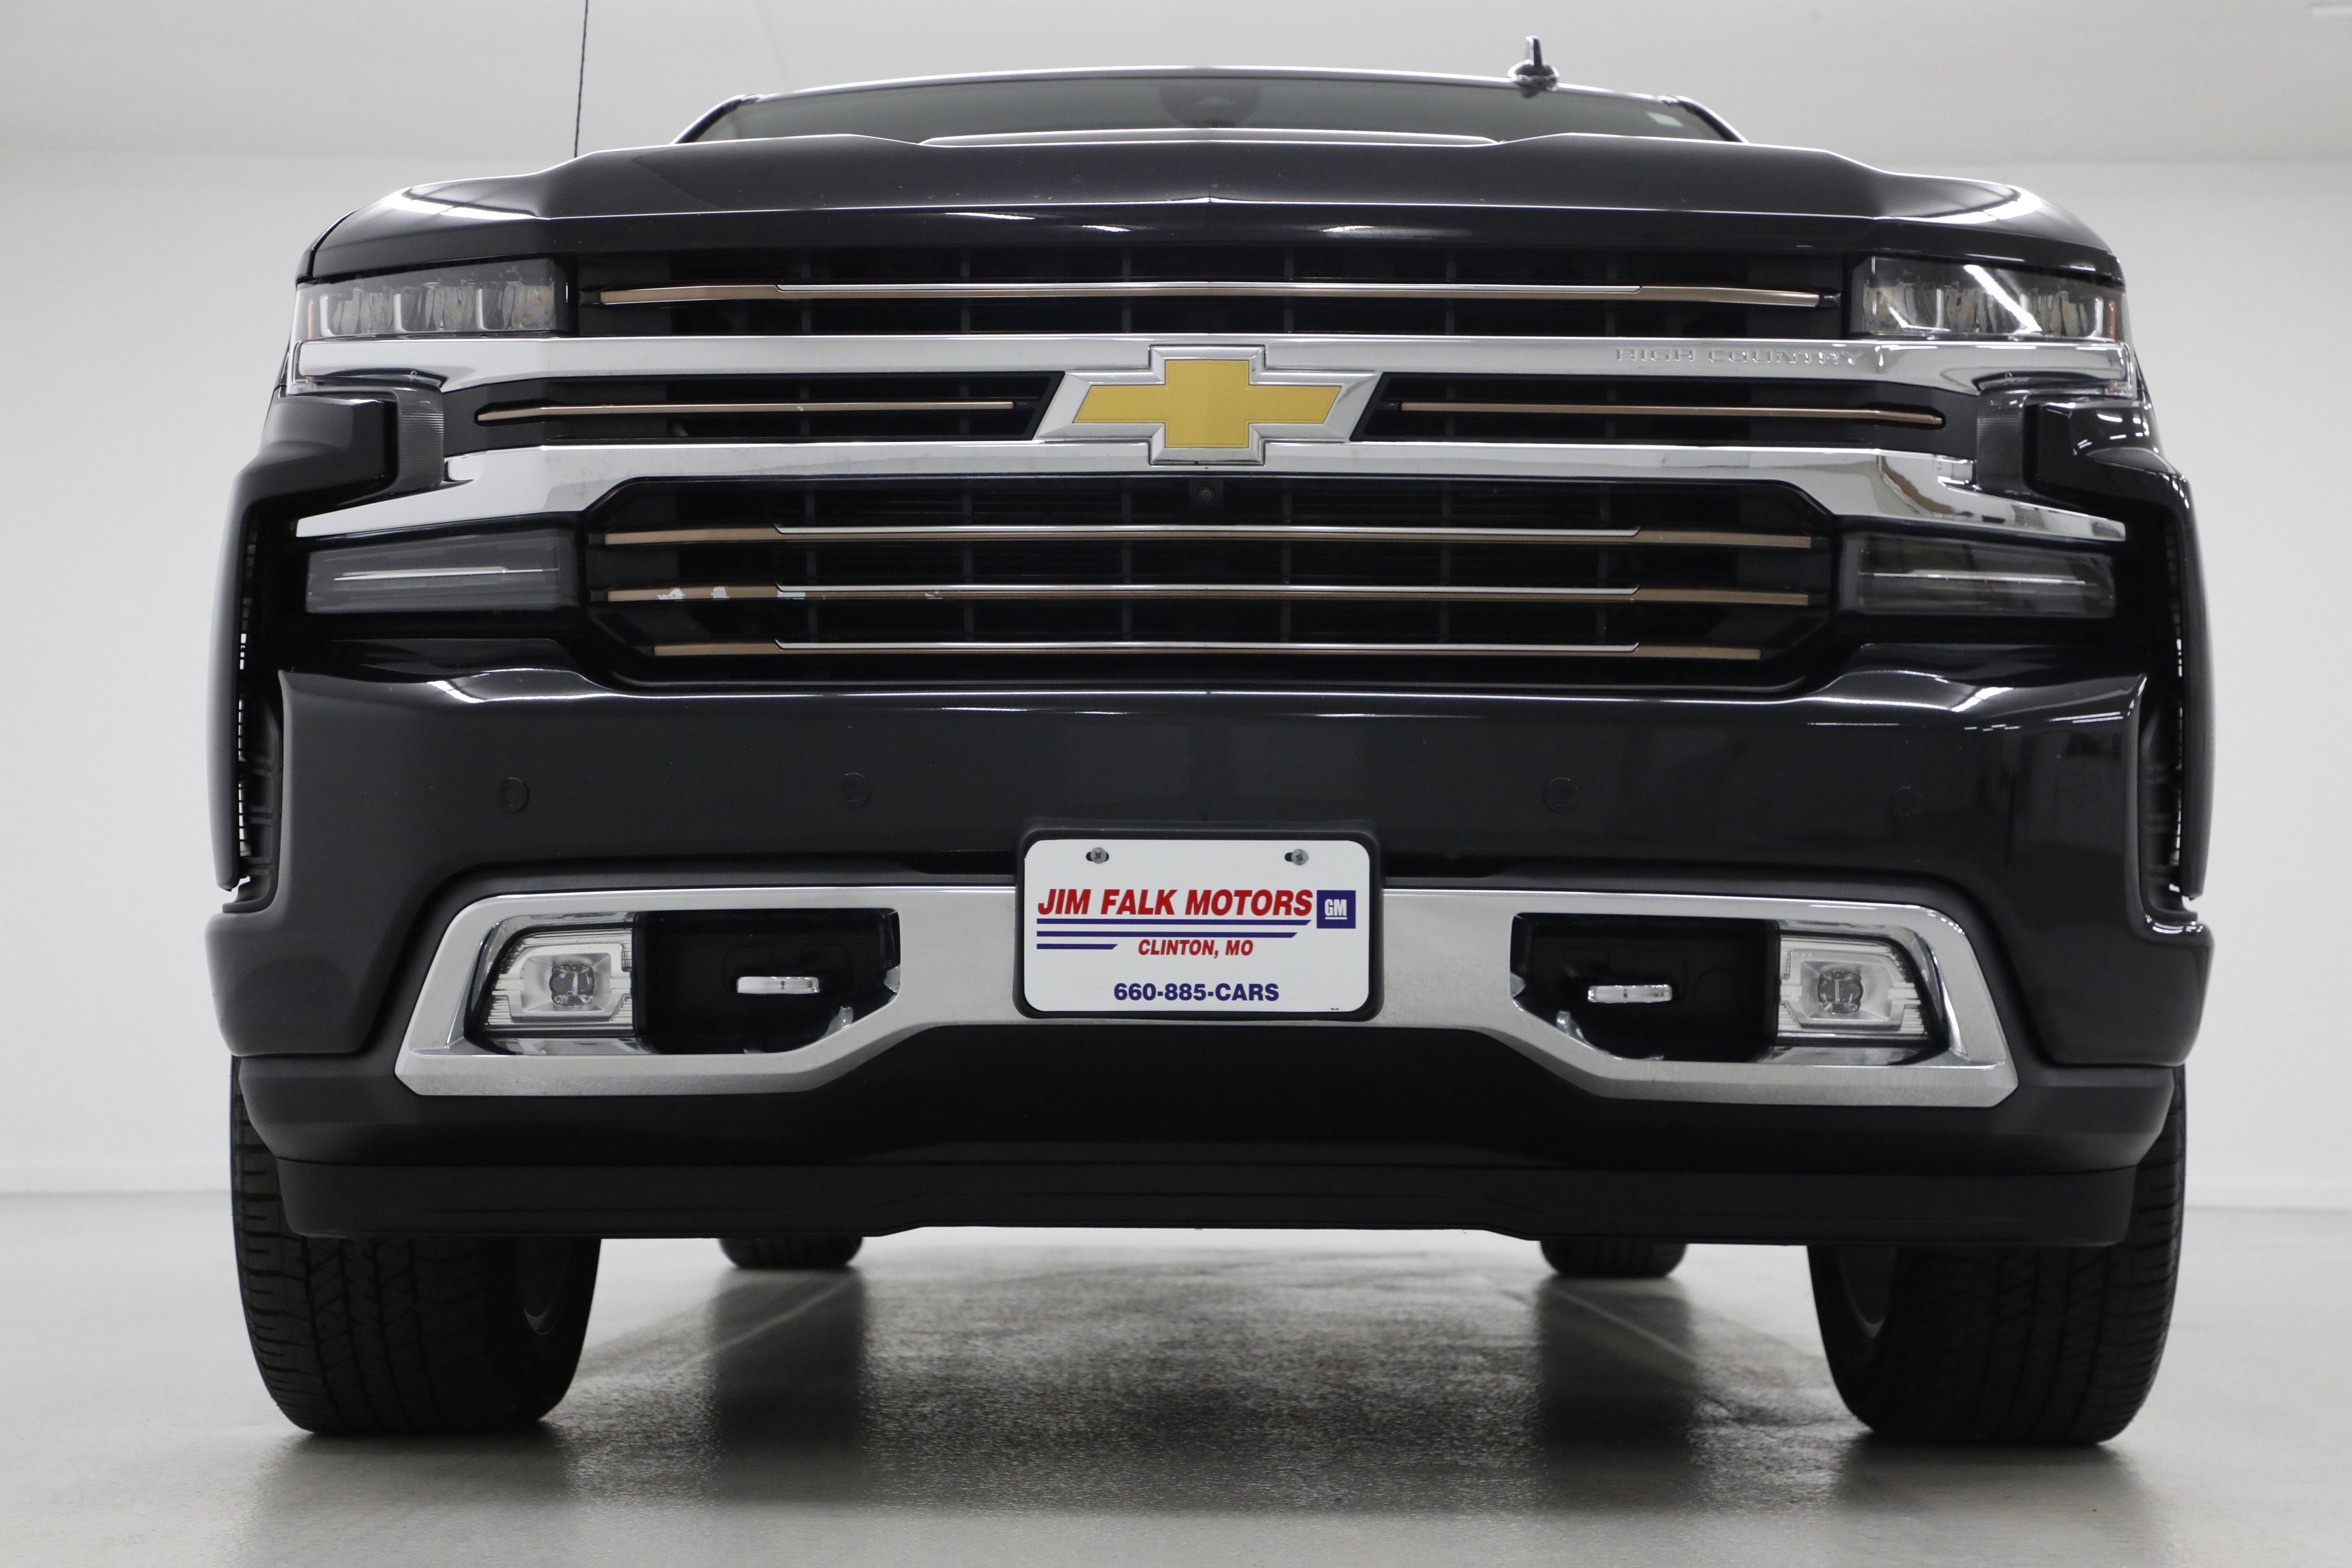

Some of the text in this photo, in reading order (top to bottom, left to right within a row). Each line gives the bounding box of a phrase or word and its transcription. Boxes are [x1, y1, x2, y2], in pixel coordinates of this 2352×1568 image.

[1616, 348, 1864, 365] HIGH COUNTRY
[1038, 889, 1313, 916] JIM FALK MOTORS
[1324, 898, 1347, 917] GM
[1138, 939, 1254, 958] CLINTON, MO
[1114, 983, 1279, 1001] 660-885-CARS
